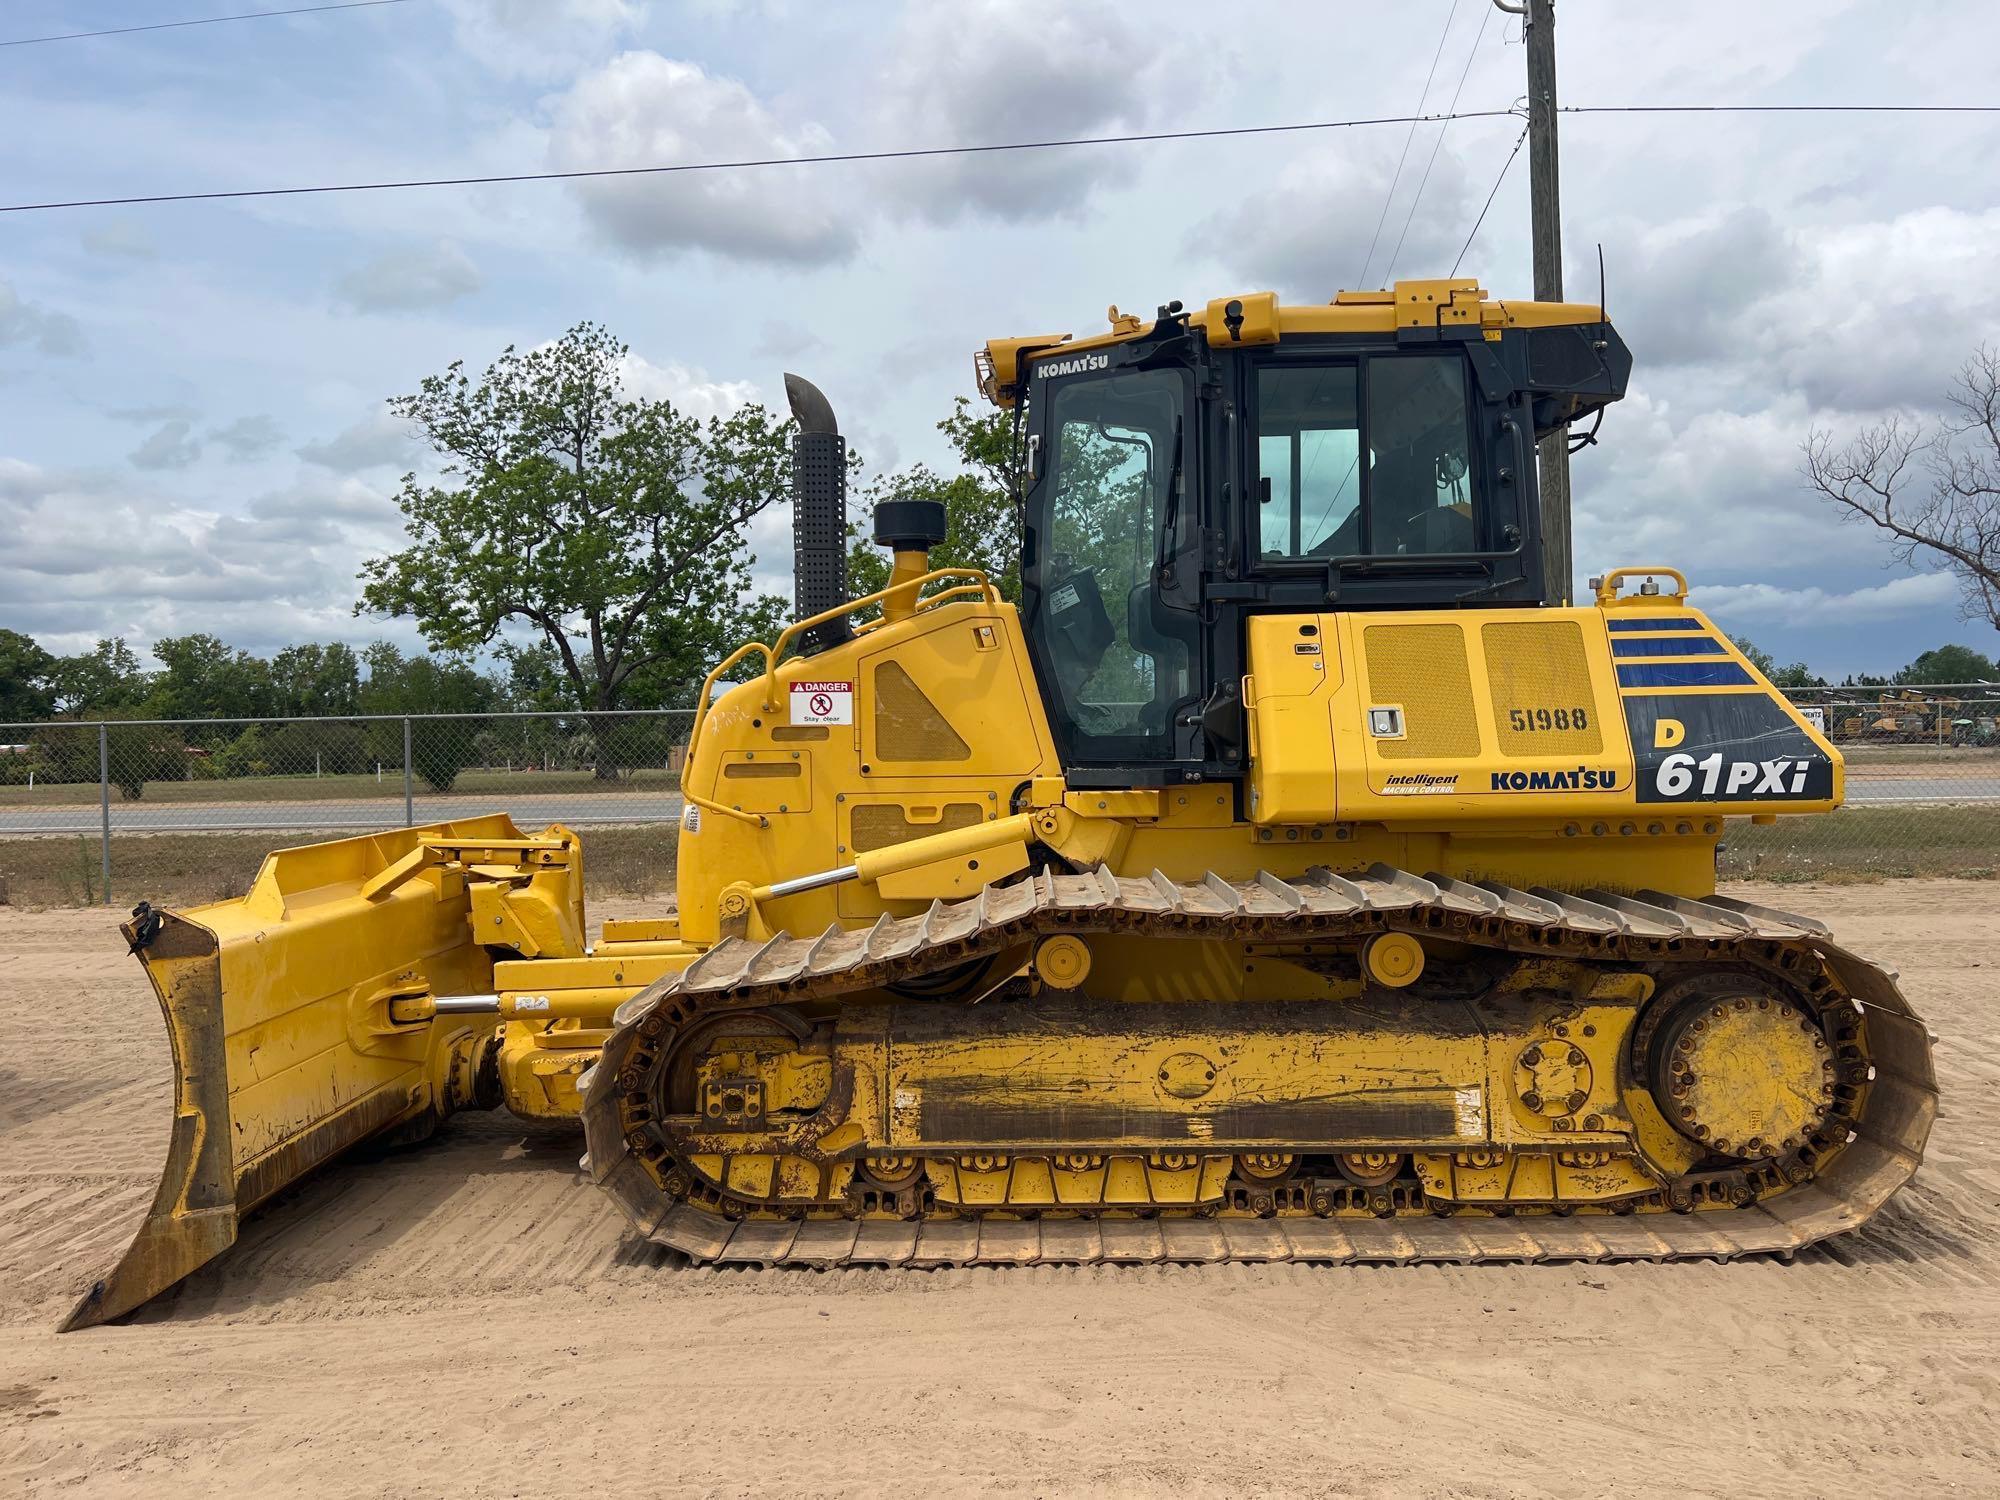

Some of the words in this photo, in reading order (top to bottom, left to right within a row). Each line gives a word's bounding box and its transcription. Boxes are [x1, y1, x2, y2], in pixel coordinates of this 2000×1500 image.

[1038, 354, 1109, 378] KOMATSU
[805, 682, 848, 692] DANGER
[1509, 708, 1588, 732] 51988
[1654, 718, 1686, 748] D
[1386, 774, 1459, 787] intelligent
[1491, 765, 1616, 791] KOMATSU
[1656, 752, 1810, 797] 61PXi
[1381, 786, 1419, 795] MACHINE
[1419, 785, 1456, 794] CONTROL
